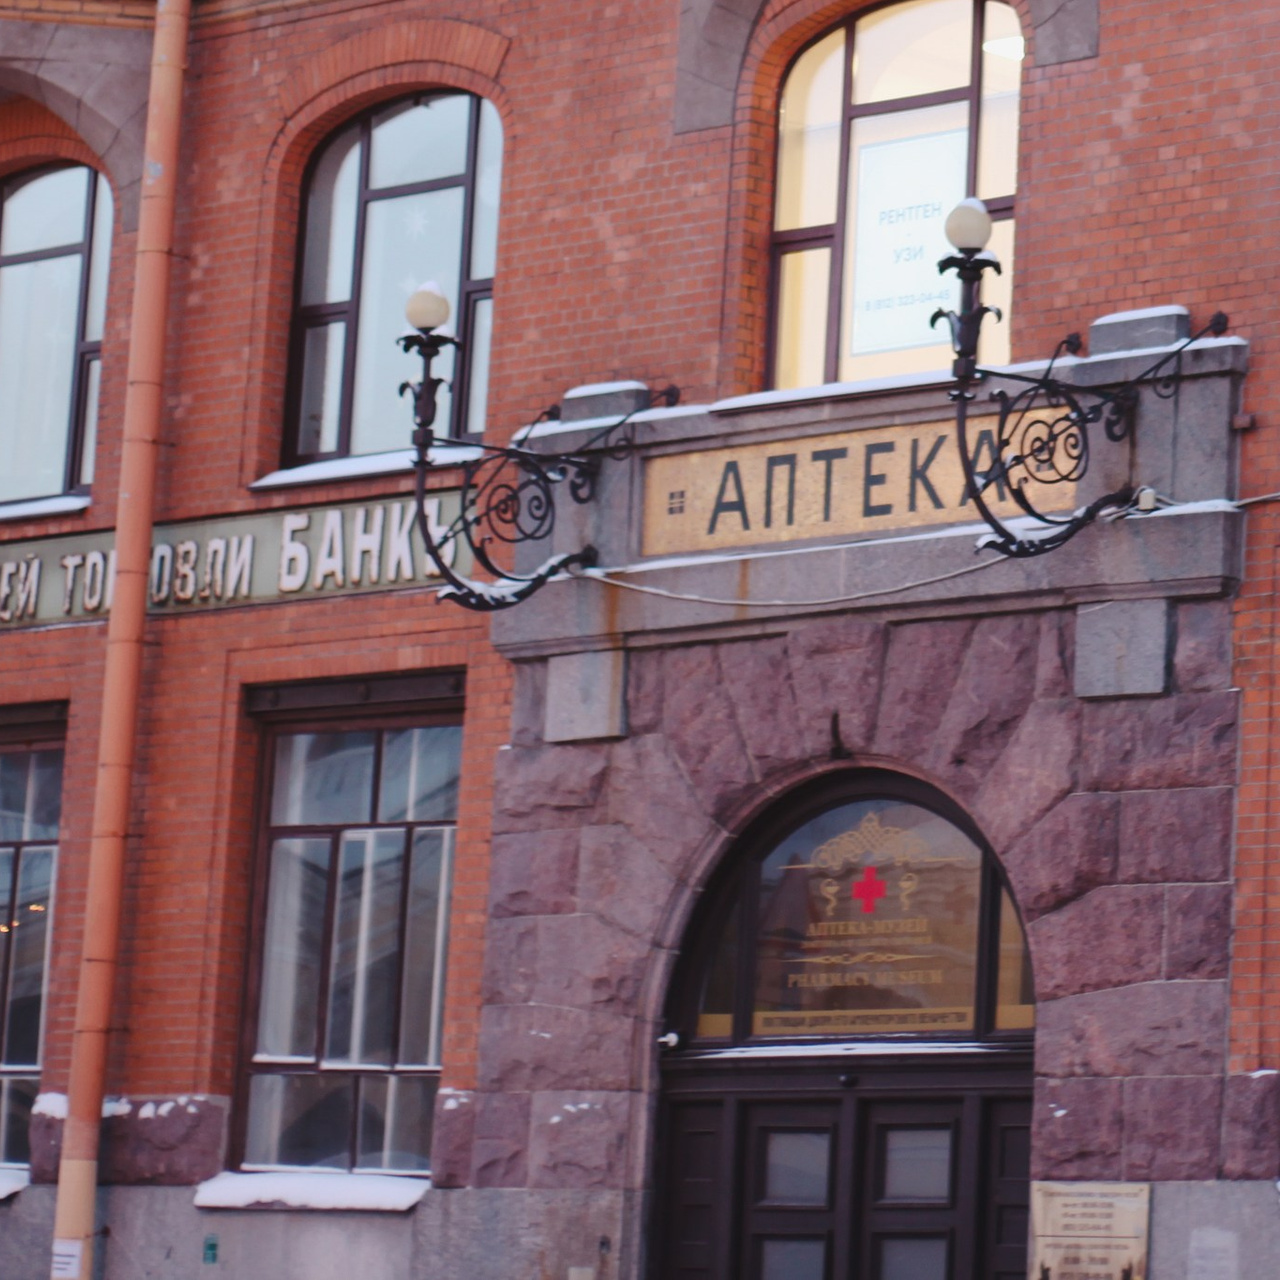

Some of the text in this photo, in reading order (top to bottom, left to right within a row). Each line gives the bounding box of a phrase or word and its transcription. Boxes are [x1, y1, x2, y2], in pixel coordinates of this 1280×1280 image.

[878, 202, 942, 226] РЕНТГЕН
[708, 429, 1006, 534] АПТЕКА
[61, 534, 253, 614] ТООВЛИ
[279, 498, 456, 593] БАНКЪ
